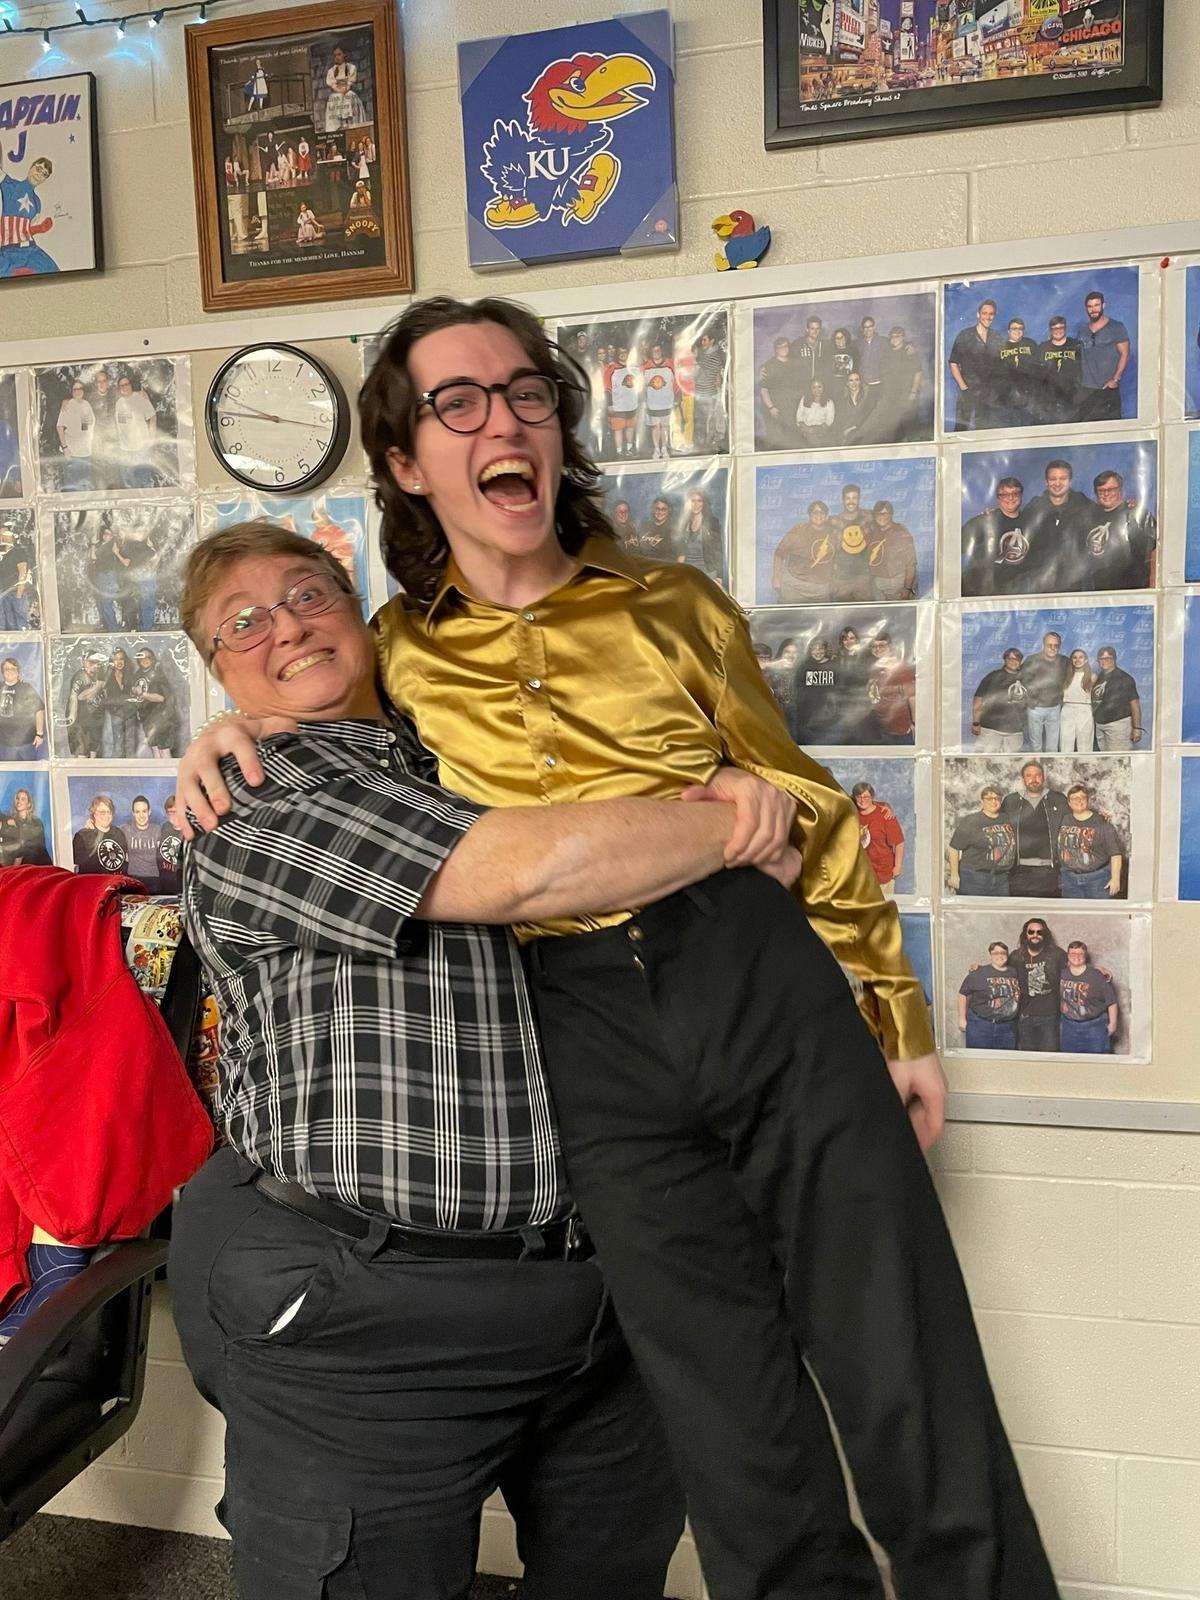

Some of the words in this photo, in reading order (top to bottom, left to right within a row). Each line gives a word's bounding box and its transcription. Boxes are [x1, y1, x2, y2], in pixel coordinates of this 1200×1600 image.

[1062, 20, 1121, 43] CHICAGO
[800, 33, 825, 49] WICKED
[0, 94, 81, 130] APTAIN
[7, 130, 28, 163] J
[526, 147, 571, 180] KU
[345, 220, 379, 237] SNOOPY
[267, 360, 283, 373] 12
[295, 363, 304, 378] 1
[310, 383, 327, 399] 2
[220, 416, 235, 427] 9
[319, 413, 334, 424] 3
[229, 442, 243, 455] 8
[315, 438, 330, 452] 4
[274, 466, 285, 483] 6
[297, 458, 311, 475] 5
